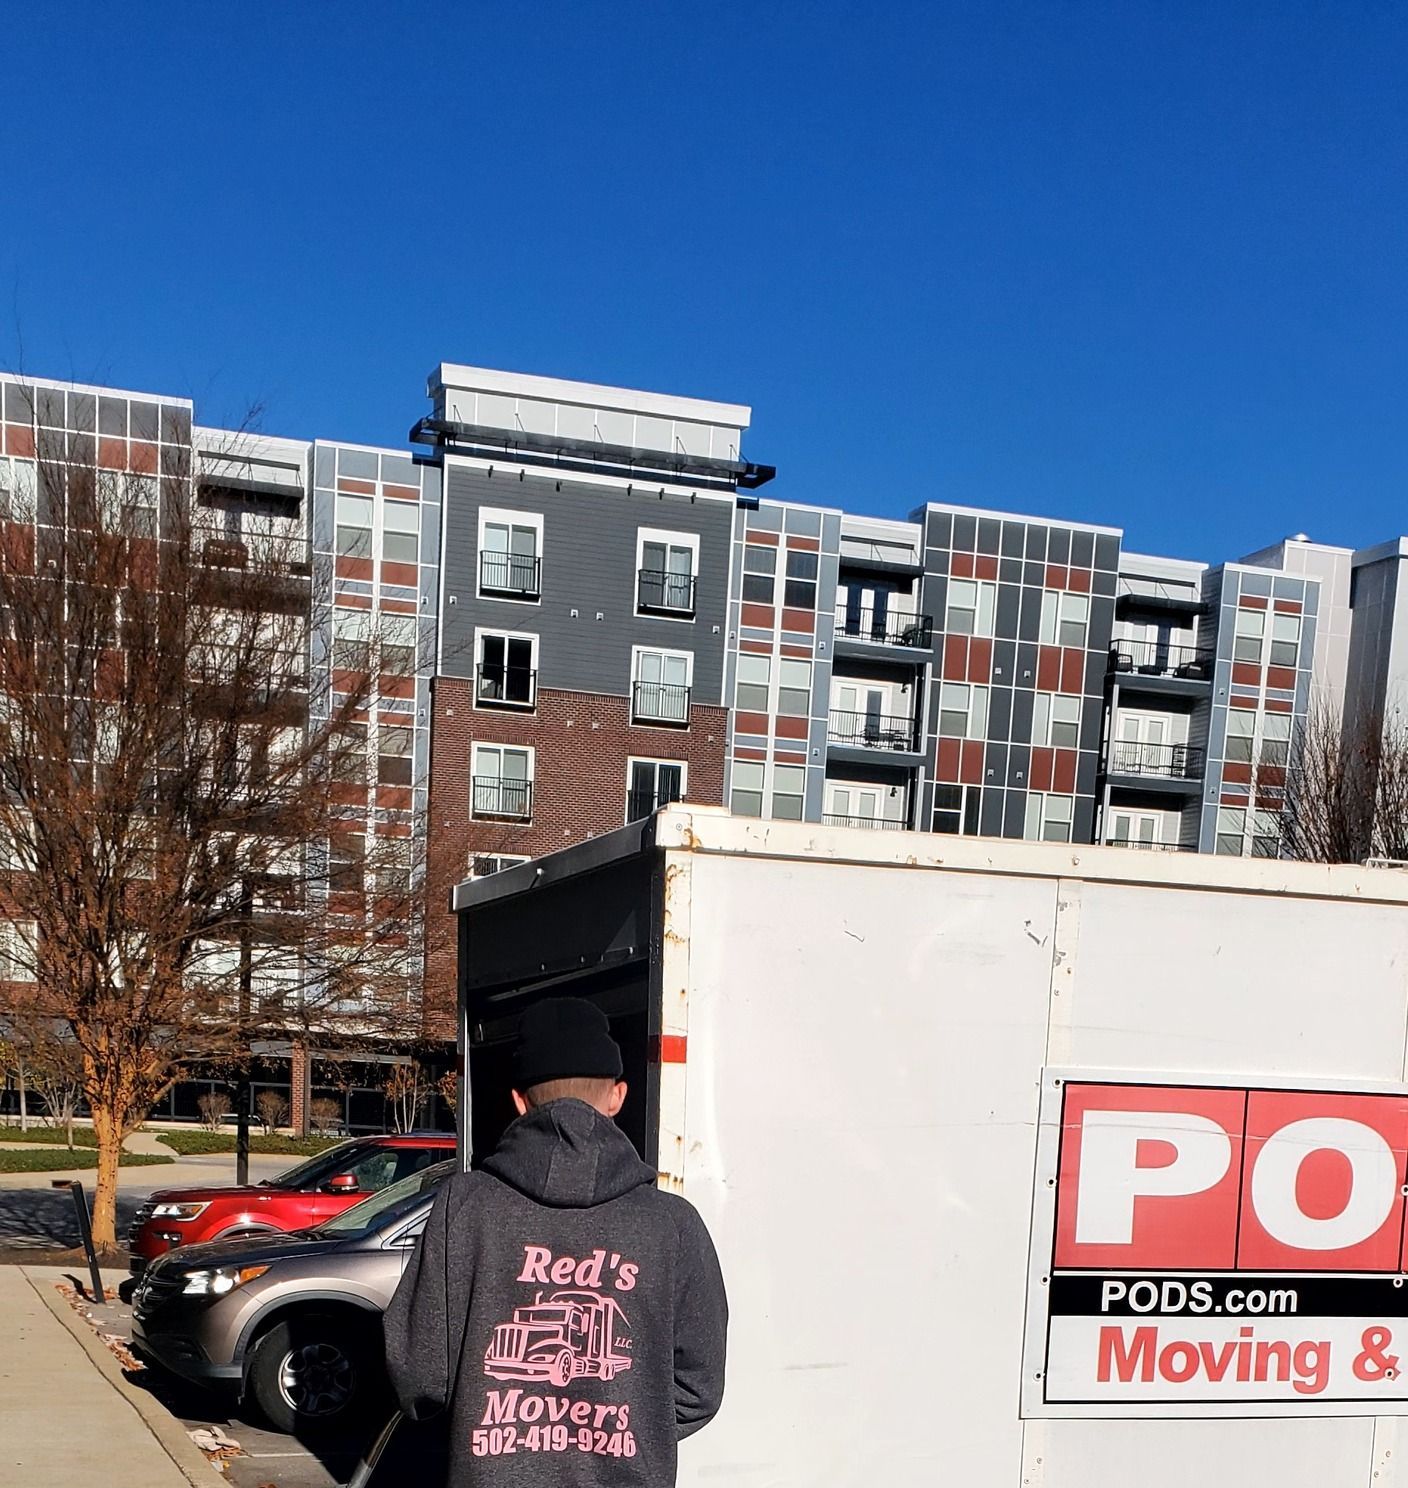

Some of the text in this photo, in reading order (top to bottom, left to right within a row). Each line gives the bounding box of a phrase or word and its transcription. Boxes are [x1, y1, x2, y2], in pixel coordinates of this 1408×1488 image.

[516, 1245, 639, 1291] Red's
[1100, 1280, 1298, 1313] PODS.com
[1096, 1325, 1400, 1394] Moving &
[480, 1389, 630, 1431] Movers
[472, 1424, 637, 1457] 502-419-9246
